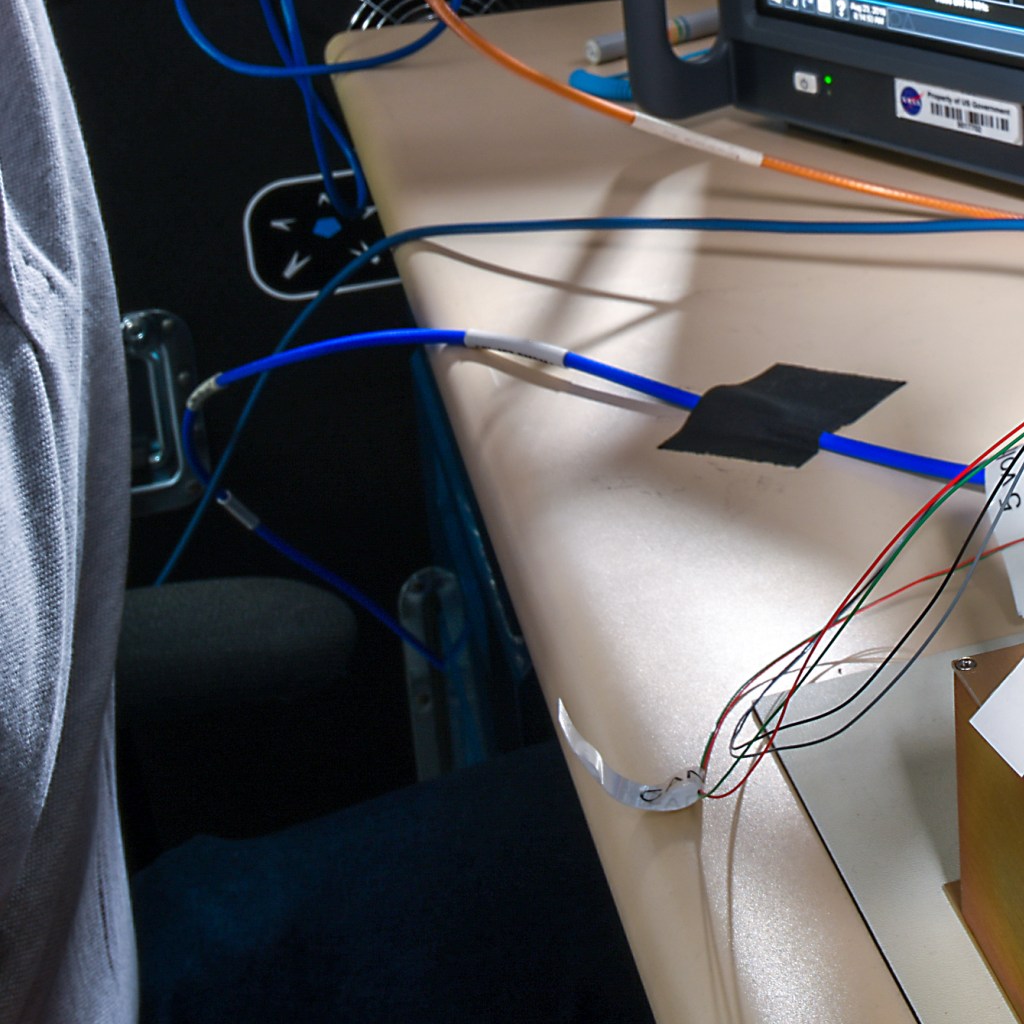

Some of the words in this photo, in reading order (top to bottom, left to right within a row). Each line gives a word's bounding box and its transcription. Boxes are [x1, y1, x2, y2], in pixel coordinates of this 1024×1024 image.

[900, 96, 922, 106] NASA
[927, 91, 953, 105] Property
[954, 97, 962, 105] of
[962, 98, 971, 107] US
[972, 101, 1011, 116] Government
